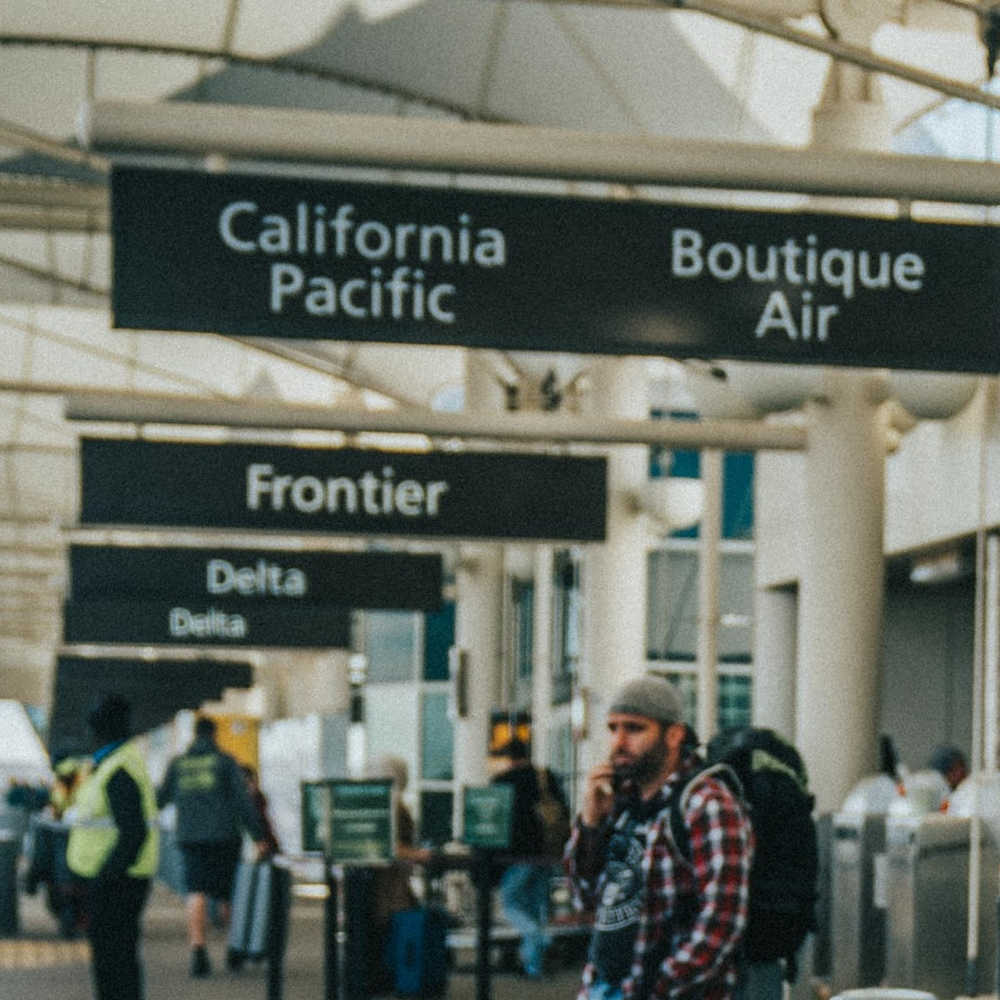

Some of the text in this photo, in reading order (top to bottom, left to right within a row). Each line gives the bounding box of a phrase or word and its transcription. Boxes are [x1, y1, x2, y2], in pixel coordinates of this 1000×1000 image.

[219, 200, 507, 266] California
[671, 228, 925, 298] Boutique
[270, 263, 455, 323] Pacific
[755, 289, 838, 341] Air
[245, 463, 447, 516] Frontier
[206, 559, 307, 597] Delta
[169, 607, 247, 640] Delta
